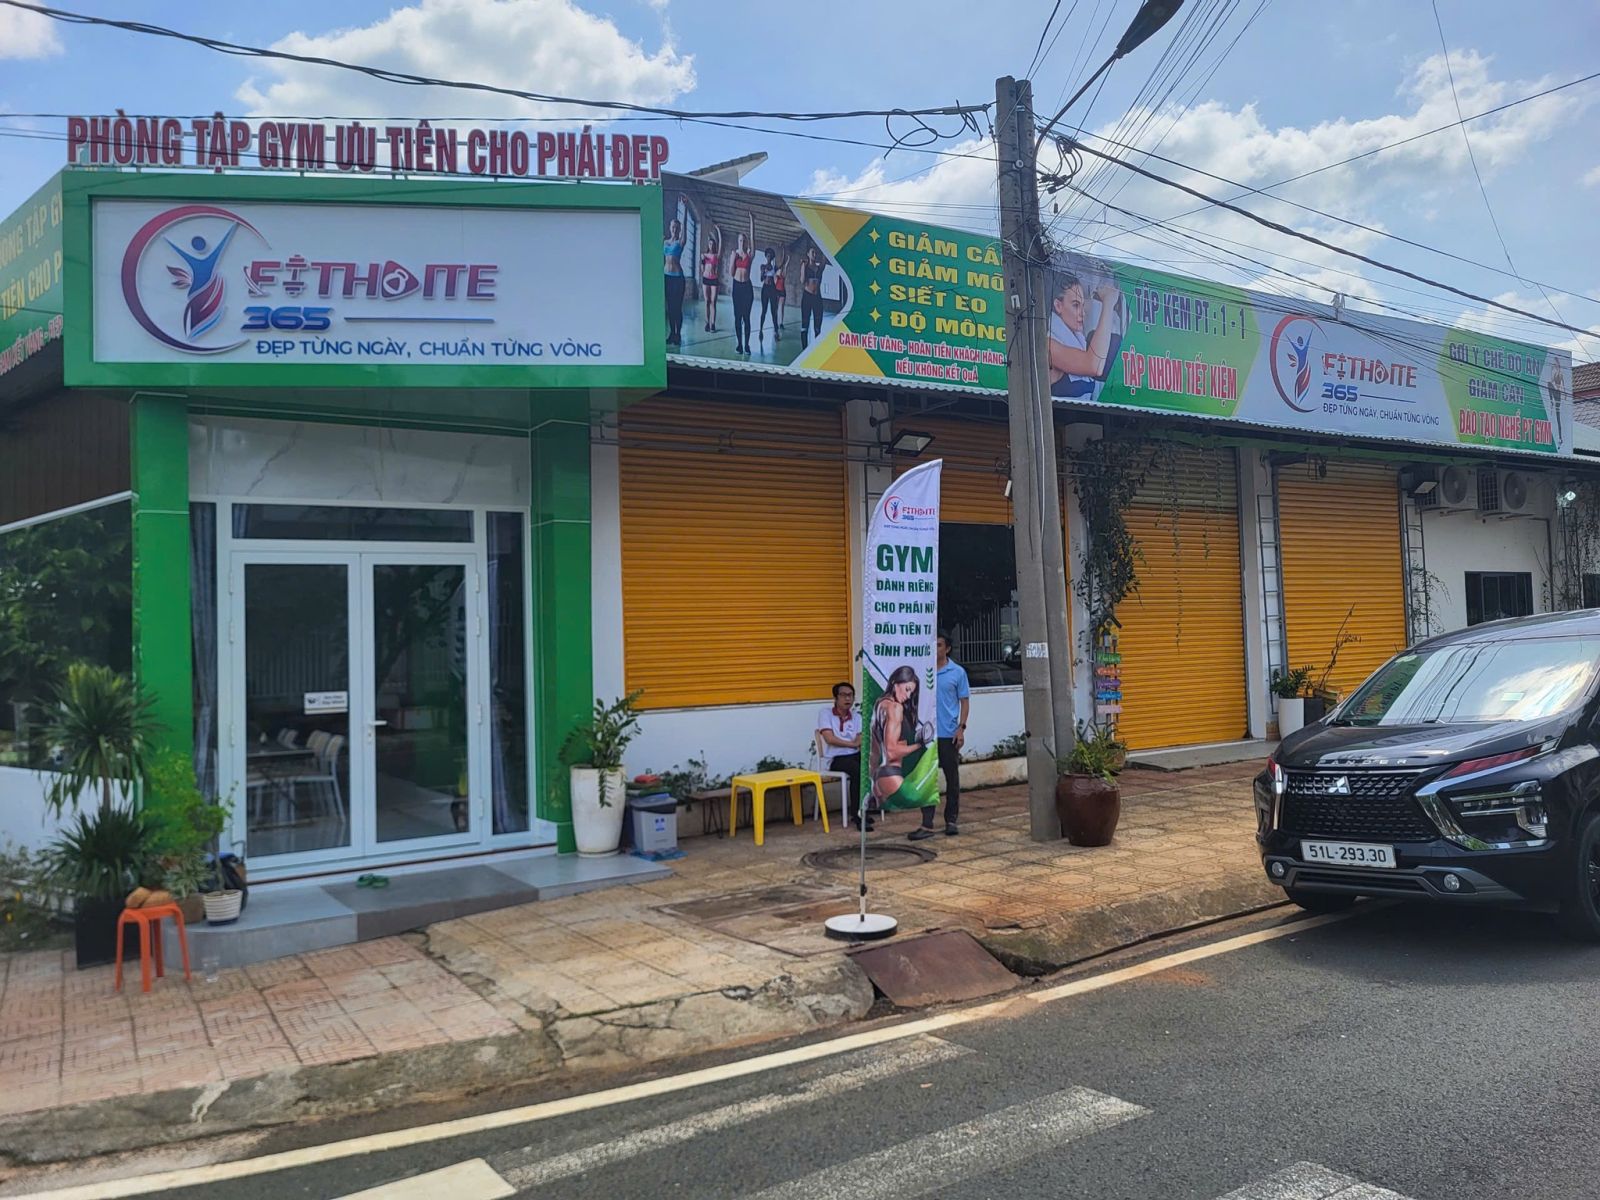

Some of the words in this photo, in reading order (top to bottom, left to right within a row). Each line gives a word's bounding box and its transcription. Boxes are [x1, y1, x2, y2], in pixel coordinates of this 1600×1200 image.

[67, 108, 182, 166] PHÒNG
[191, 111, 251, 174] TẬP
[257, 121, 325, 170] GYM
[385, 119, 457, 174] TIÊN
[466, 128, 530, 176] CHO
[537, 124, 605, 178] PHÁI
[611, 133, 669, 186] ĐẸP
[26, 205, 47, 248] TẬP
[888, 231, 959, 258] GIẢM
[966, 244, 1003, 267] CÂ
[28, 259, 51, 302] CHO
[888, 258, 959, 284] GIẢM
[890, 284, 947, 308] SIẾT
[955, 295, 988, 314] EO
[1134, 282, 1160, 333] TẬP
[1195, 299, 1210, 335] PT
[240, 306, 333, 333] 365
[890, 310, 927, 334] ĐỘ
[935, 317, 1007, 342] MÔNG
[256, 341, 295, 358] ĐẸP
[299, 336, 352, 356] TỪNG
[357, 337, 411, 358] NGÀY,
[419, 337, 485, 357] CHUẨN
[491, 338, 543, 357] TỪNG
[549, 338, 602, 357] VÒNG
[838, 332, 860, 347] CAM
[861, 332, 879, 351] KẾT
[908, 338, 932, 358] HOÀN
[933, 340, 952, 360] TIỀN
[953, 345, 981, 363] KHÁCH
[982, 348, 1005, 366] HÀNG
[1483, 346, 1505, 370] CHẾ
[895, 358, 914, 376] NẾU
[914, 361, 944, 379] KHÔNG
[945, 363, 962, 380] KẾT
[1121, 345, 1145, 396] TẬP
[1148, 350, 1183, 393] NHÓM
[1185, 352, 1208, 397] TIẾT
[1210, 359, 1238, 407] KIỆM
[1321, 382, 1358, 402] 365
[1468, 375, 1498, 401] GIẢM
[1323, 402, 1338, 416] ĐẸP
[1338, 402, 1358, 416] TỪNG
[1380, 409, 1403, 420] CHUẨN
[1403, 411, 1421, 424] TỪNG
[1422, 415, 1440, 426] VÒNG
[1459, 404, 1477, 436] ĐÀO
[1479, 411, 1496, 443] TẠO
[1498, 409, 1521, 441] NGHỀ
[1523, 418, 1533, 443] PT
[1534, 420, 1552, 445] GYM
[876, 543, 934, 574] GYM
[876, 578, 905, 592] DÀNH
[908, 579, 934, 593] RIÊNG
[874, 601, 896, 613] CHO
[898, 601, 923, 614] PHÁI
[899, 622, 922, 635] TIÊN
[874, 643, 900, 657] BÌNH
[1309, 844, 1387, 863] 51L-293.30
